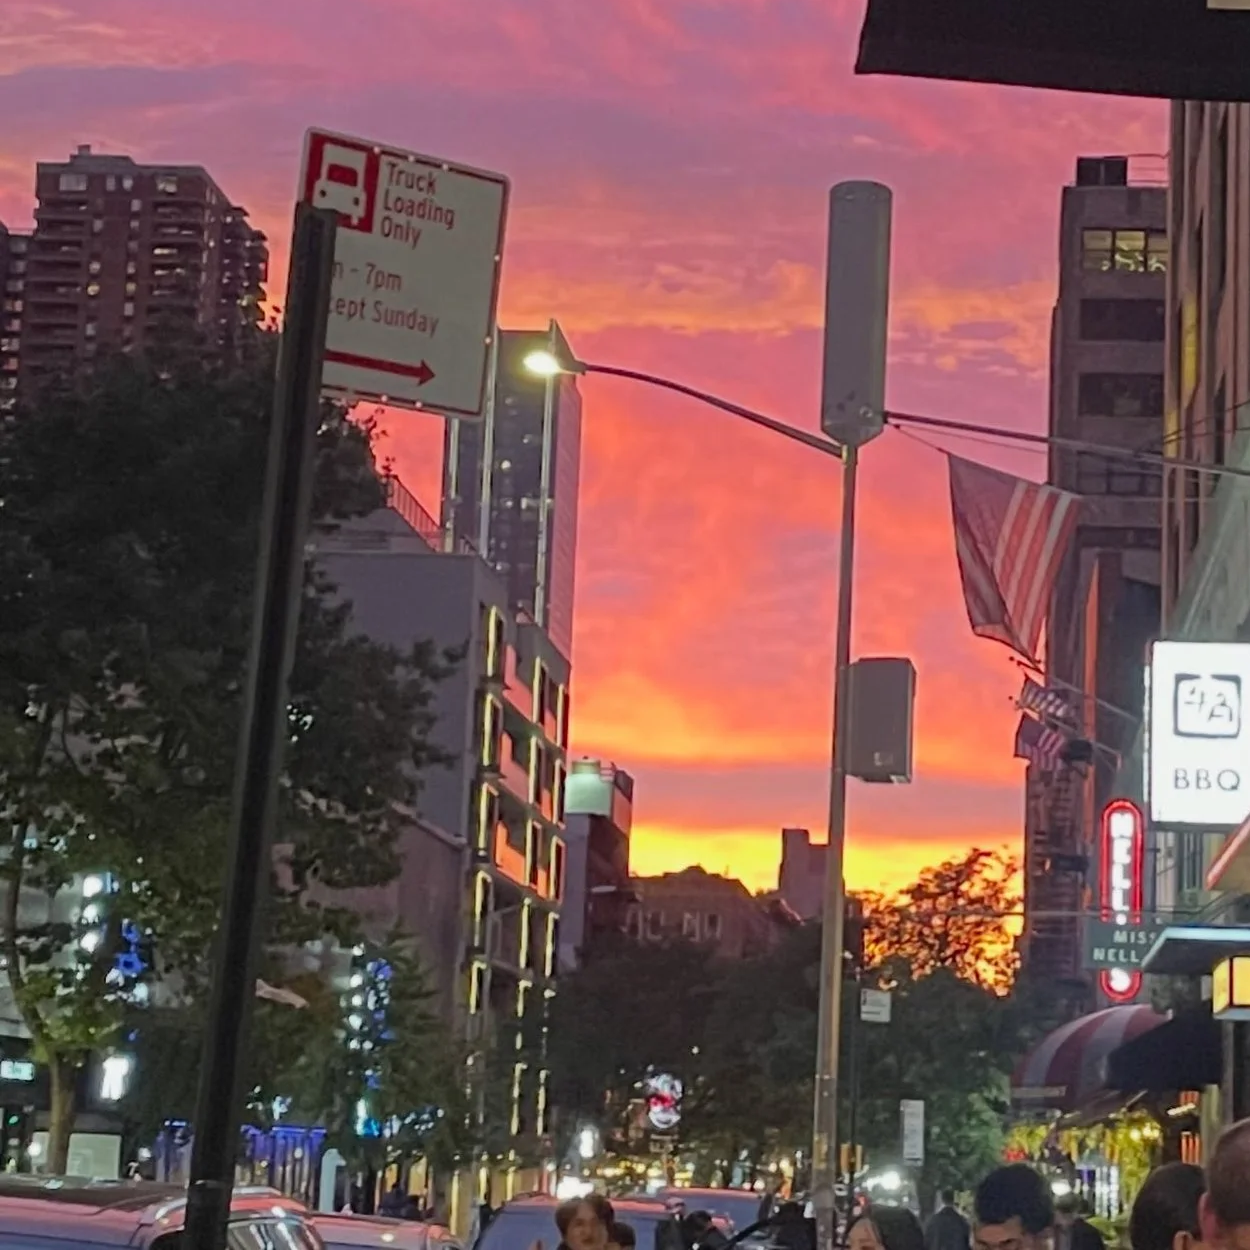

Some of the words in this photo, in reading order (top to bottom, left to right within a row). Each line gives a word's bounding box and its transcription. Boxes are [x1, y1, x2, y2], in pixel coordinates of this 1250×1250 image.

[386, 161, 437, 196] Truck
[384, 188, 456, 231] Loading
[381, 216, 422, 250] Only
[366, 262, 402, 291] 7pm
[372, 300, 440, 339] Sunday
[1174, 768, 1240, 791] BBQ
[1093, 947, 1140, 963] NELL
